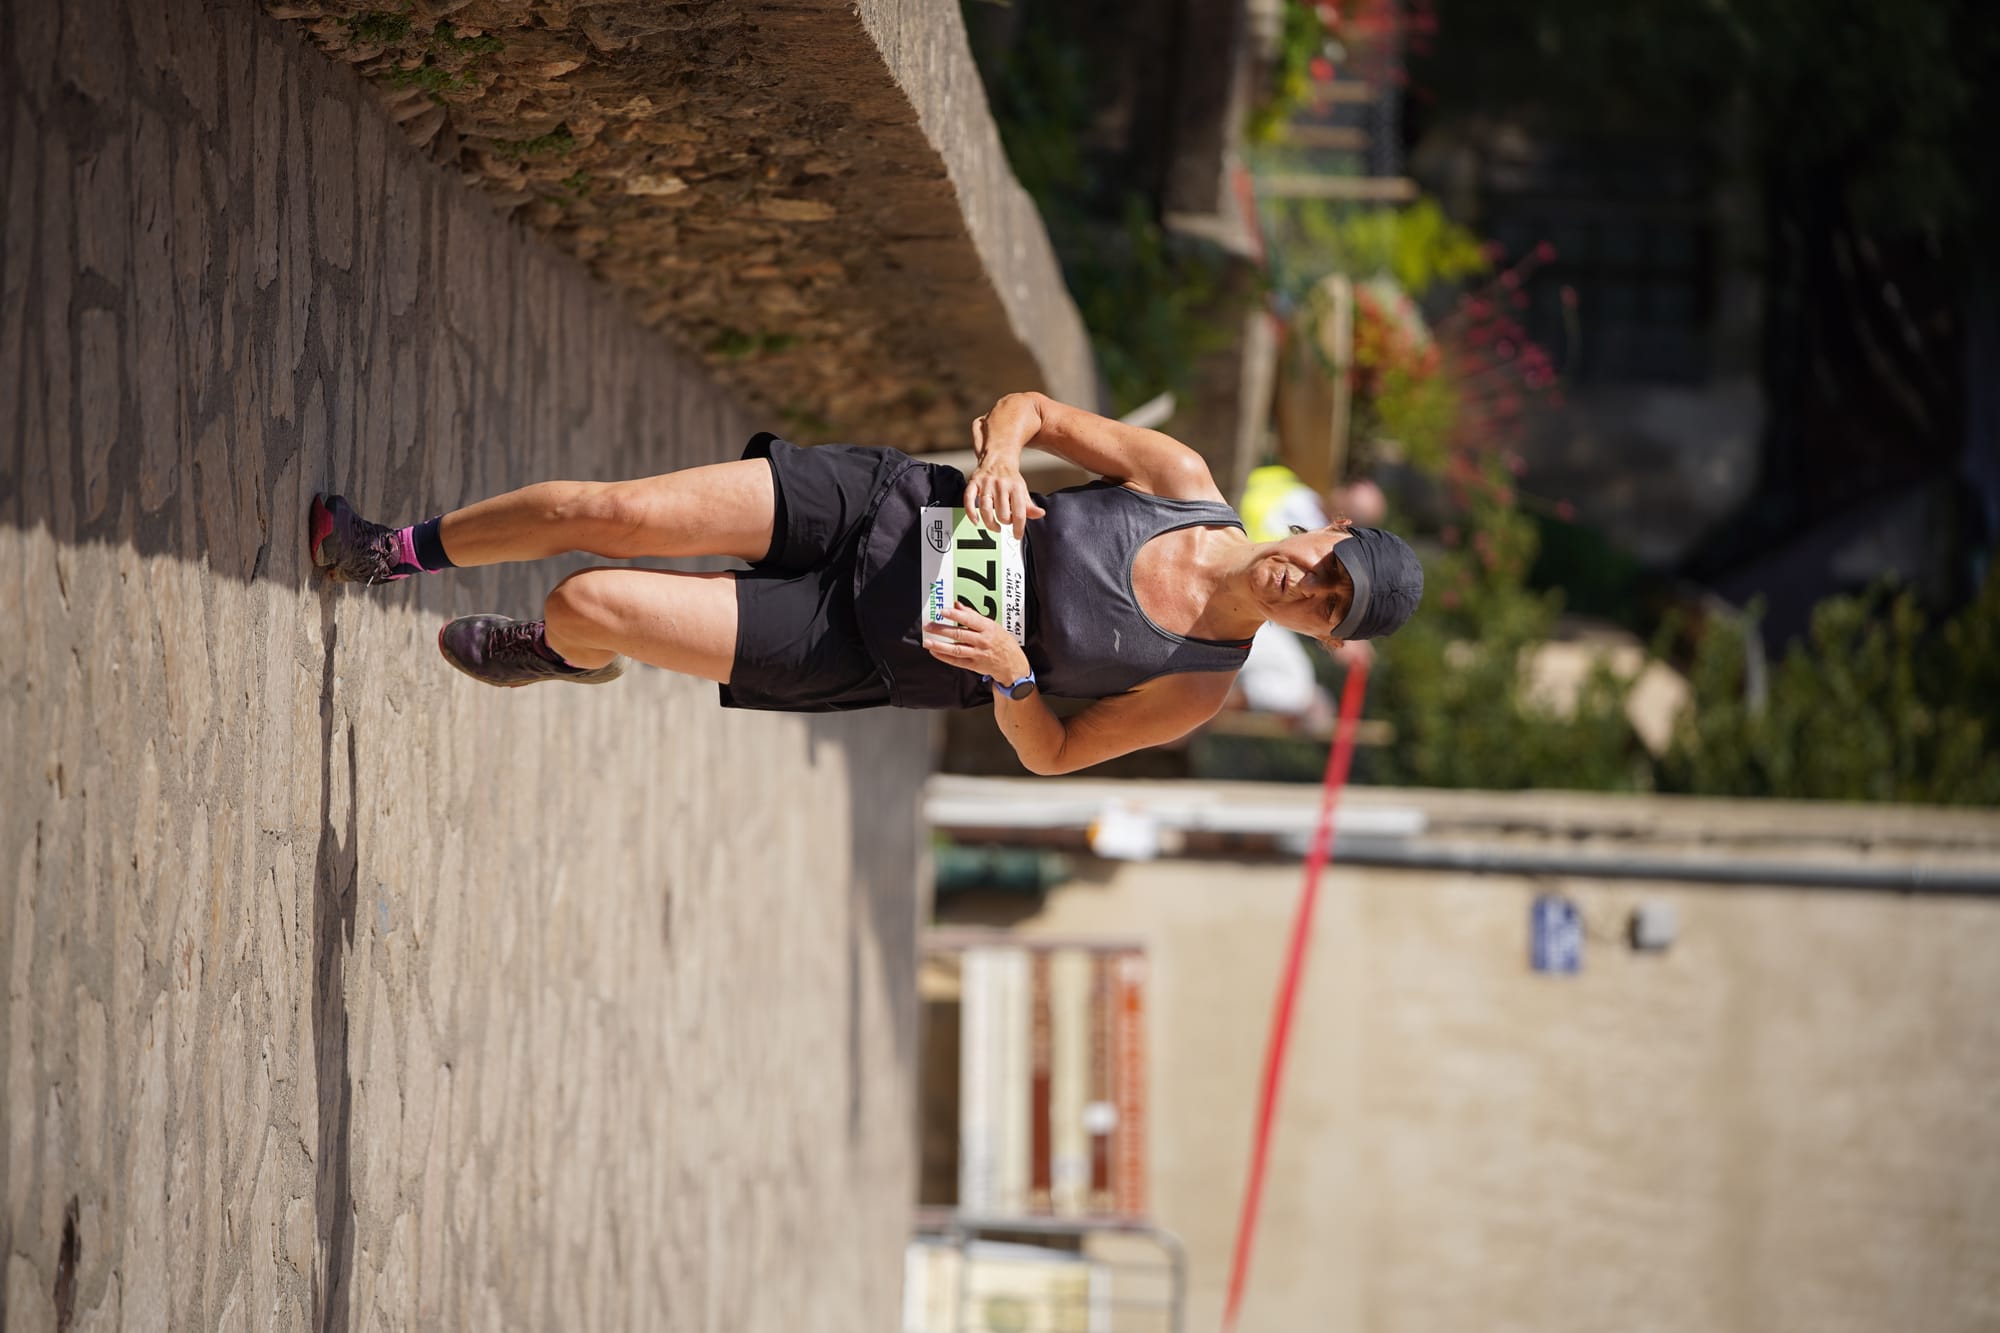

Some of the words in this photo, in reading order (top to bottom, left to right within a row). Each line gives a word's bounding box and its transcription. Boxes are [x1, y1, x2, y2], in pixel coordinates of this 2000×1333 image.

[934, 520, 943, 549] BFP
[935, 579, 944, 621] TUFFS
[957, 529, 997, 628] 172
[1013, 572, 1021, 616] Challenge
